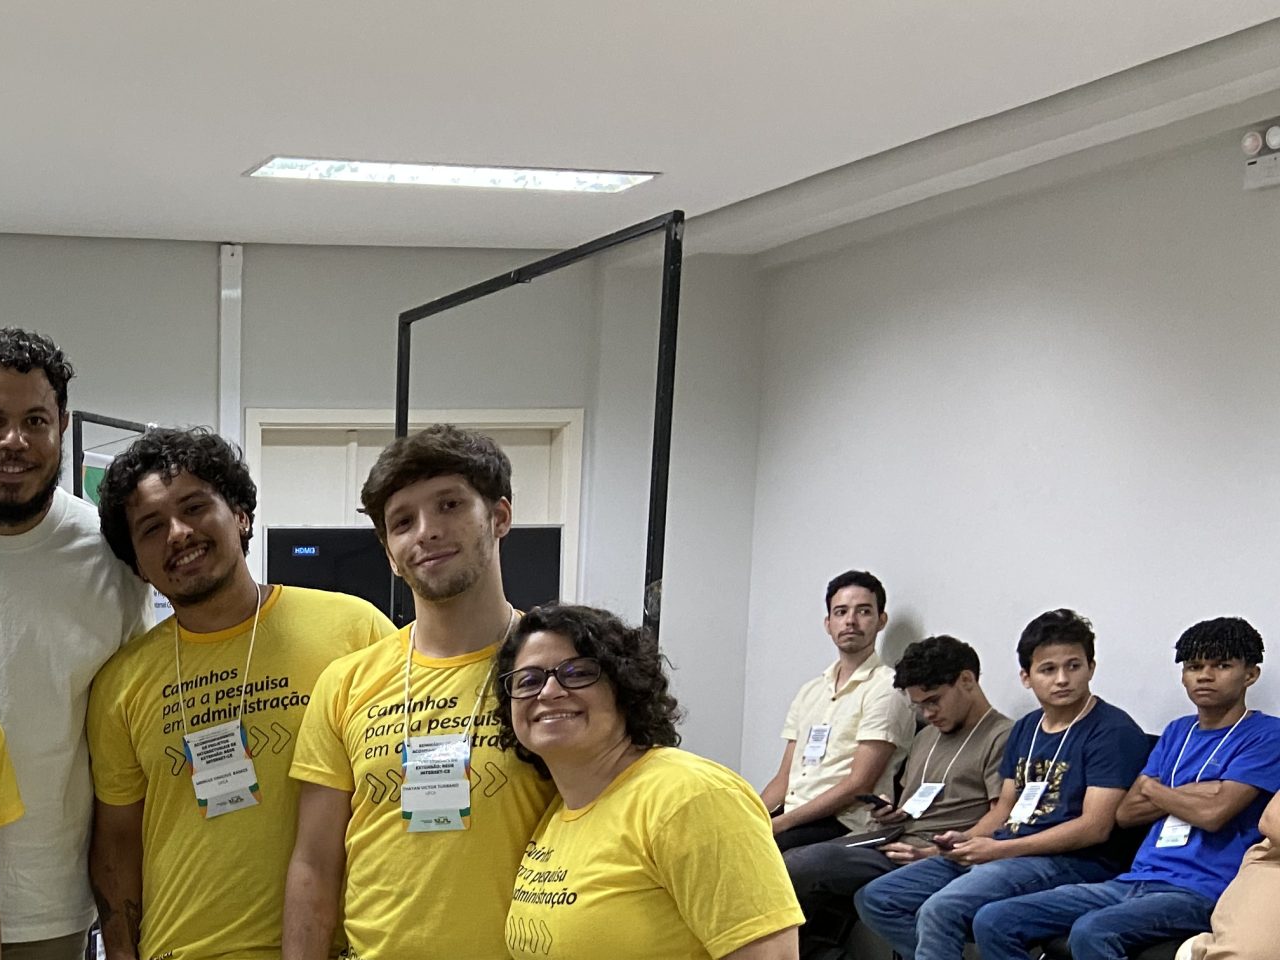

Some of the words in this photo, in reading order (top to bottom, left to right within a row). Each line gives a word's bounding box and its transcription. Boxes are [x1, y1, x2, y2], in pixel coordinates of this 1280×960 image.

[162, 668, 239, 698] Caminhos
[200, 693, 211, 705] a
[214, 676, 290, 704] pesquisa
[367, 695, 459, 720] Caminhos
[162, 717, 187, 735] em
[364, 722, 404, 744] para
[410, 719, 421, 732] a
[364, 744, 389, 760] em
